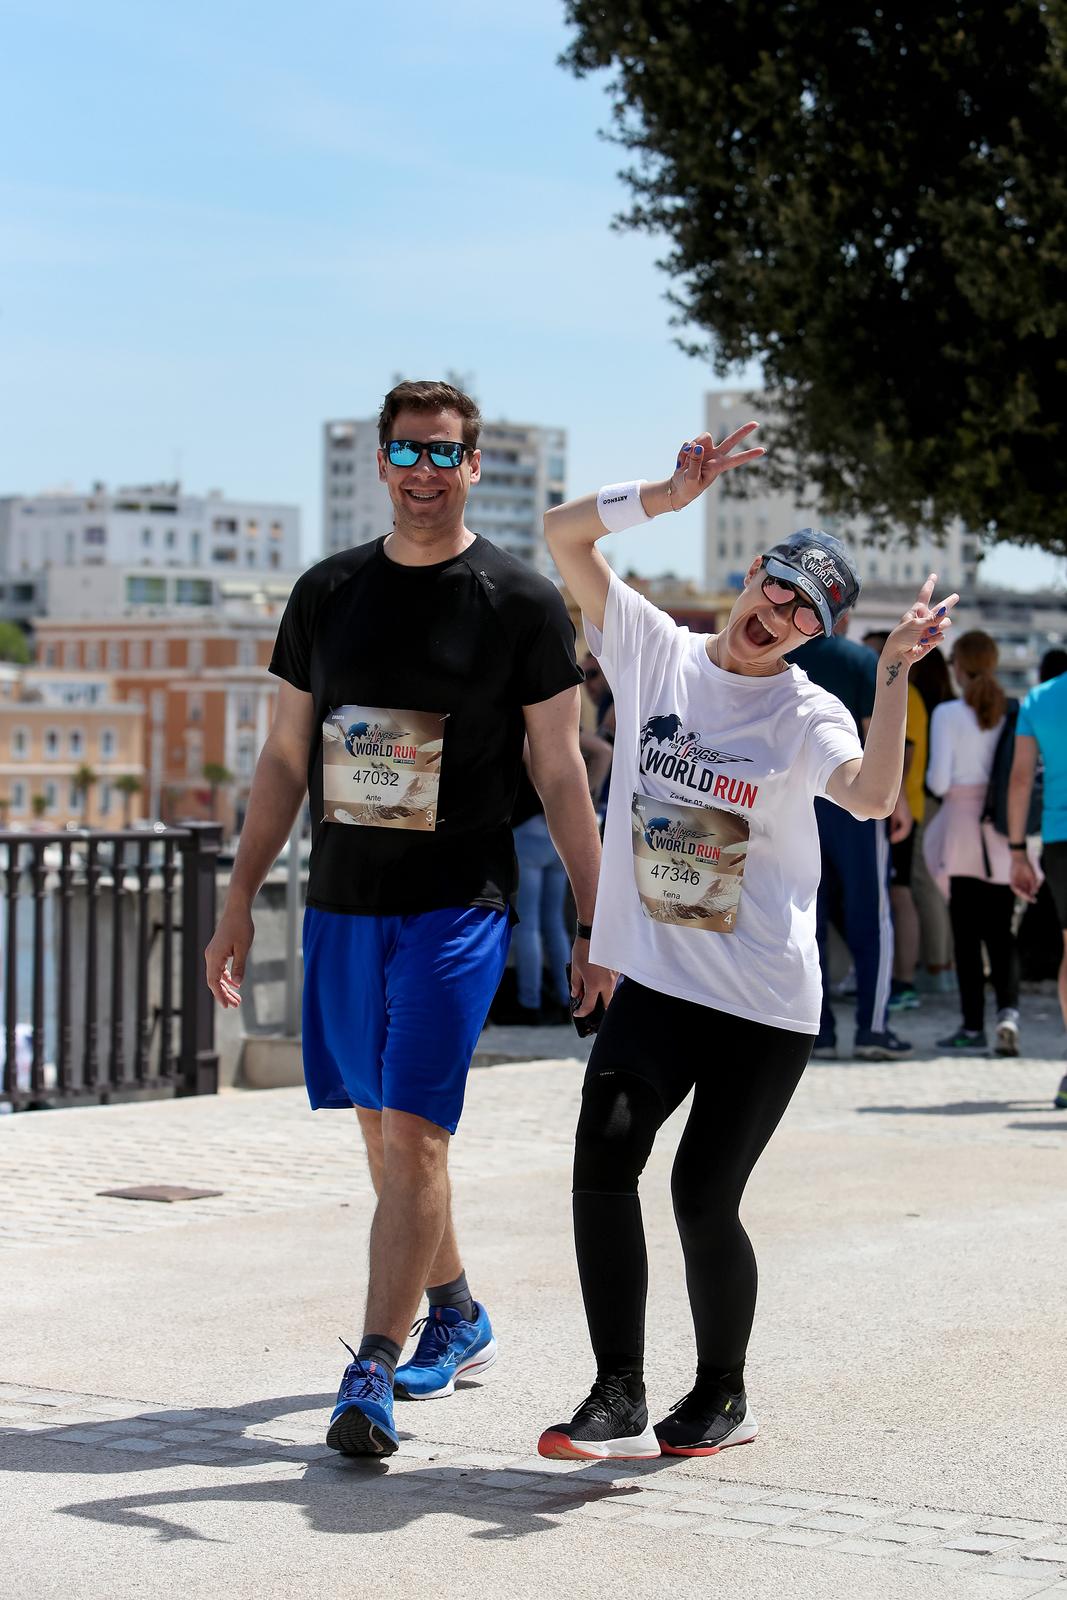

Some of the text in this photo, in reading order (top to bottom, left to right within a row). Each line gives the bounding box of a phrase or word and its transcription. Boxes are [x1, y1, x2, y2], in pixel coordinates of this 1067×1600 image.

[806, 560, 834, 588] WORLD
[355, 742, 417, 760] WORLD RUN
[674, 732, 720, 762] WINGS
[352, 769, 400, 787] 47032
[645, 747, 759, 809] WORLD RUN
[365, 794, 382, 802] Ante
[425, 810, 434, 822] 3
[655, 835, 721, 861] WORLD RUN
[650, 864, 701, 886] 47346
[662, 889, 681, 900] Tena
[723, 913, 733, 926] 4
